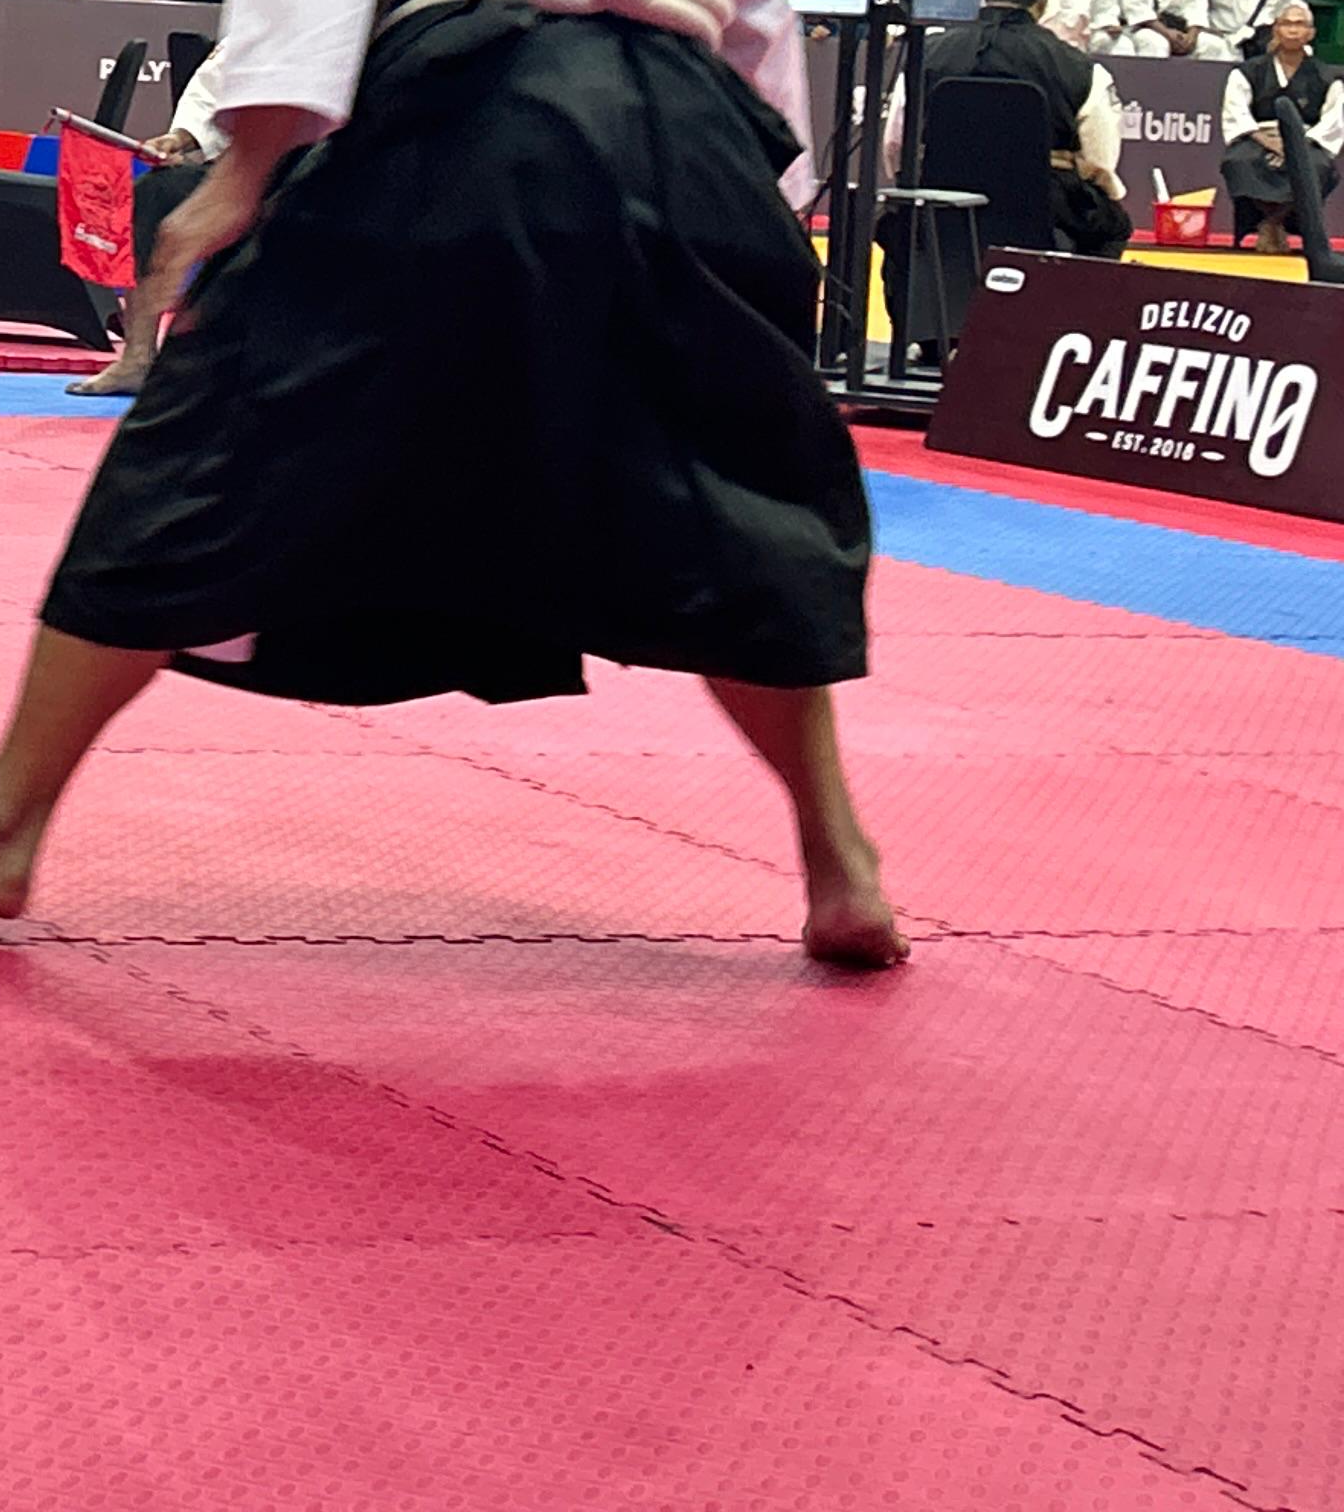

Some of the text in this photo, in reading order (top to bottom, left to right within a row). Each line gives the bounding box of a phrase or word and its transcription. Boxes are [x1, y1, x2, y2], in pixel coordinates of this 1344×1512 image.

[1145, 111, 1212, 144] blibli
[1140, 301, 1252, 342] DELIZIO
[1029, 332, 1319, 477] CAFFINO
